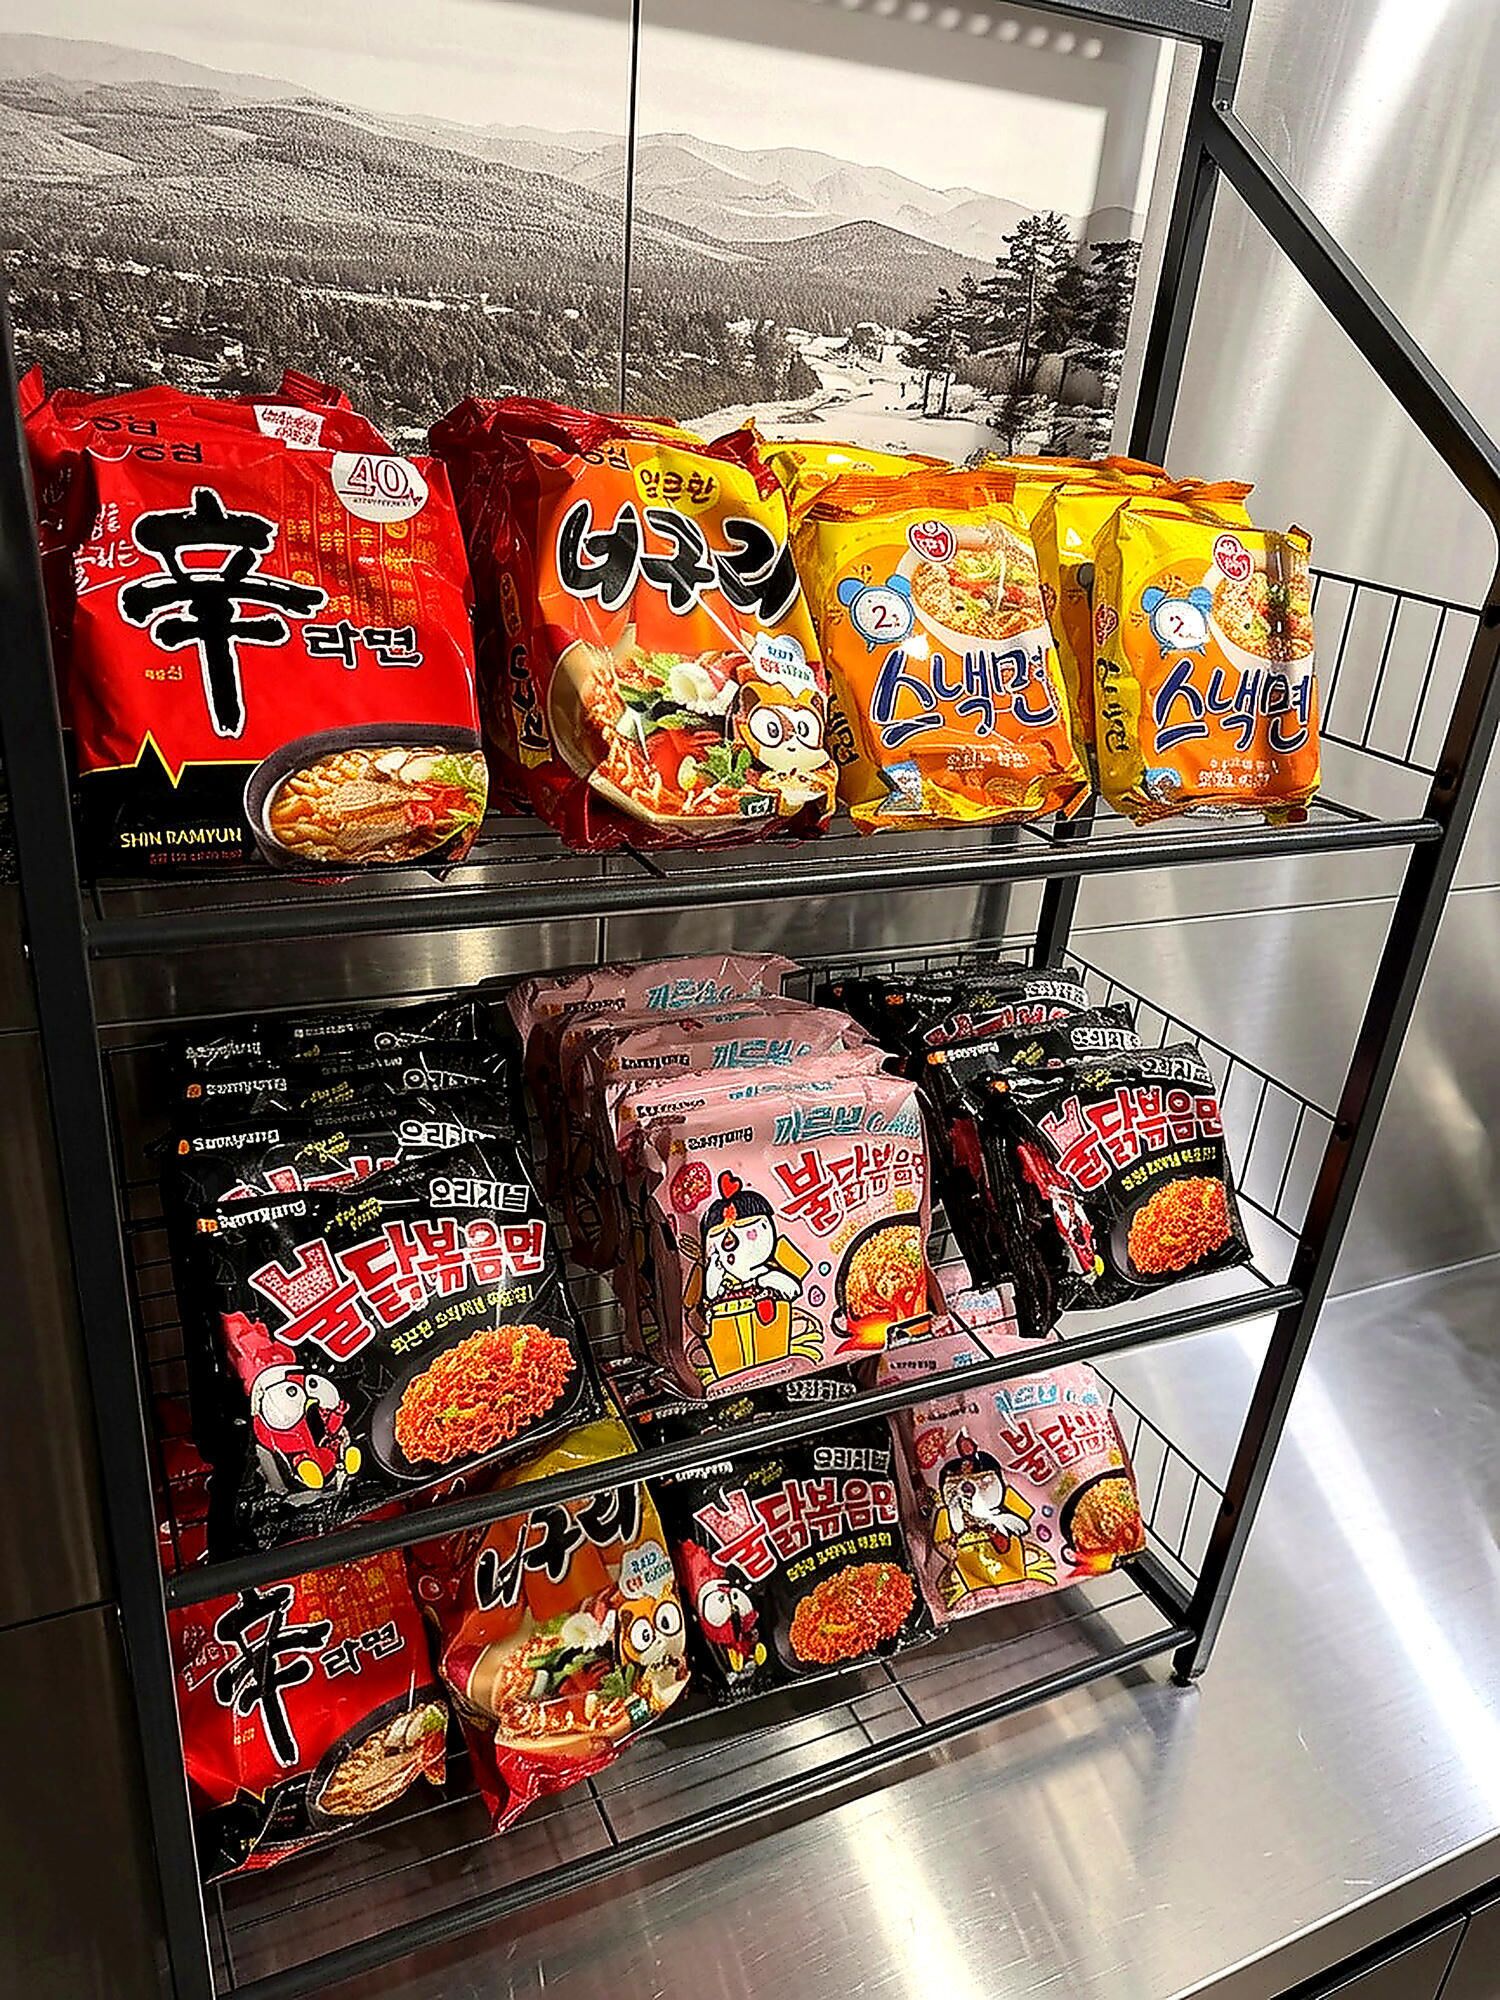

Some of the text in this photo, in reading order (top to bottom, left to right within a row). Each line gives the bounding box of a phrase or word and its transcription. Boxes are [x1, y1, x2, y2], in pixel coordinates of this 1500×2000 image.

[639, 468, 721, 505] 얼큰한
[118, 485, 330, 739] 辛
[556, 499, 800, 628] 너구리
[301, 621, 424, 670] 라면
[871, 649, 1058, 748] 스낵면
[1154, 657, 1311, 754] 스낵면
[119, 827, 243, 848] SHIN RAMYUN
[773, 1104, 864, 1147] 까르보
[1037, 1085, 1224, 1193] 불닭볶음면
[429, 1177, 531, 1214] 오리지널
[248, 1217, 546, 1363] 불닭볶음면
[474, 1480, 643, 1613] 너구리
[692, 1476, 899, 1584] 불닭볶음면
[213, 1584, 334, 1768] 辛
[319, 1619, 406, 1681] 라면
